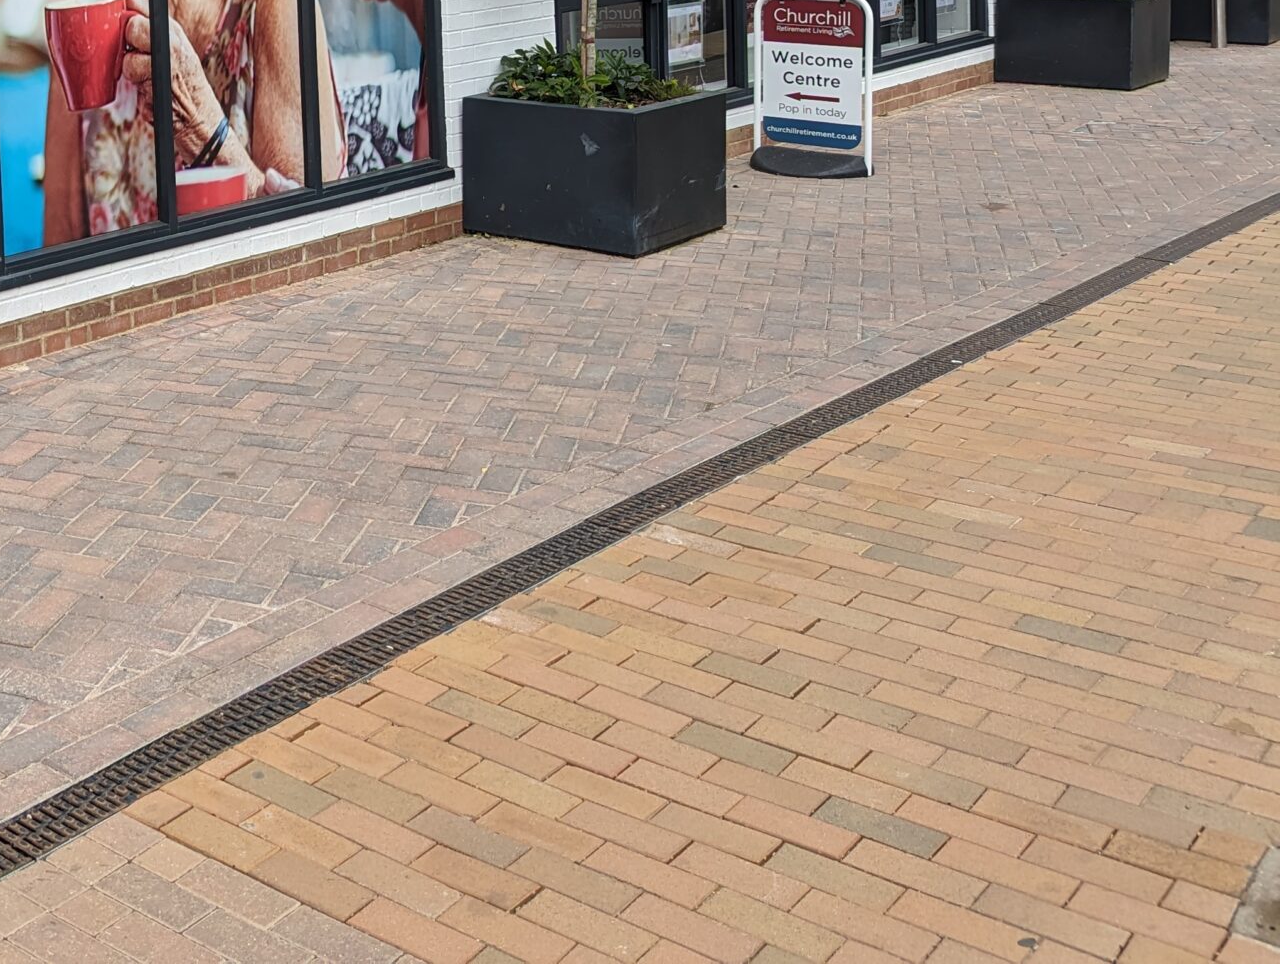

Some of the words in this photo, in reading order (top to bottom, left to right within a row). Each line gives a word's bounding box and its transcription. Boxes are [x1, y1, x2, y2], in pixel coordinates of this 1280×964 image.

[773, 7, 852, 26] Churchill
[776, 25, 811, 34] Retirement
[812, 26, 833, 36] Living
[771, 50, 853, 69] Welcome
[783, 71, 841, 88] Centre
[778, 102, 800, 115] Pop
[802, 104, 812, 114] in
[815, 106, 847, 120] today
[766, 125, 858, 141] churchillretirement.co.uk
